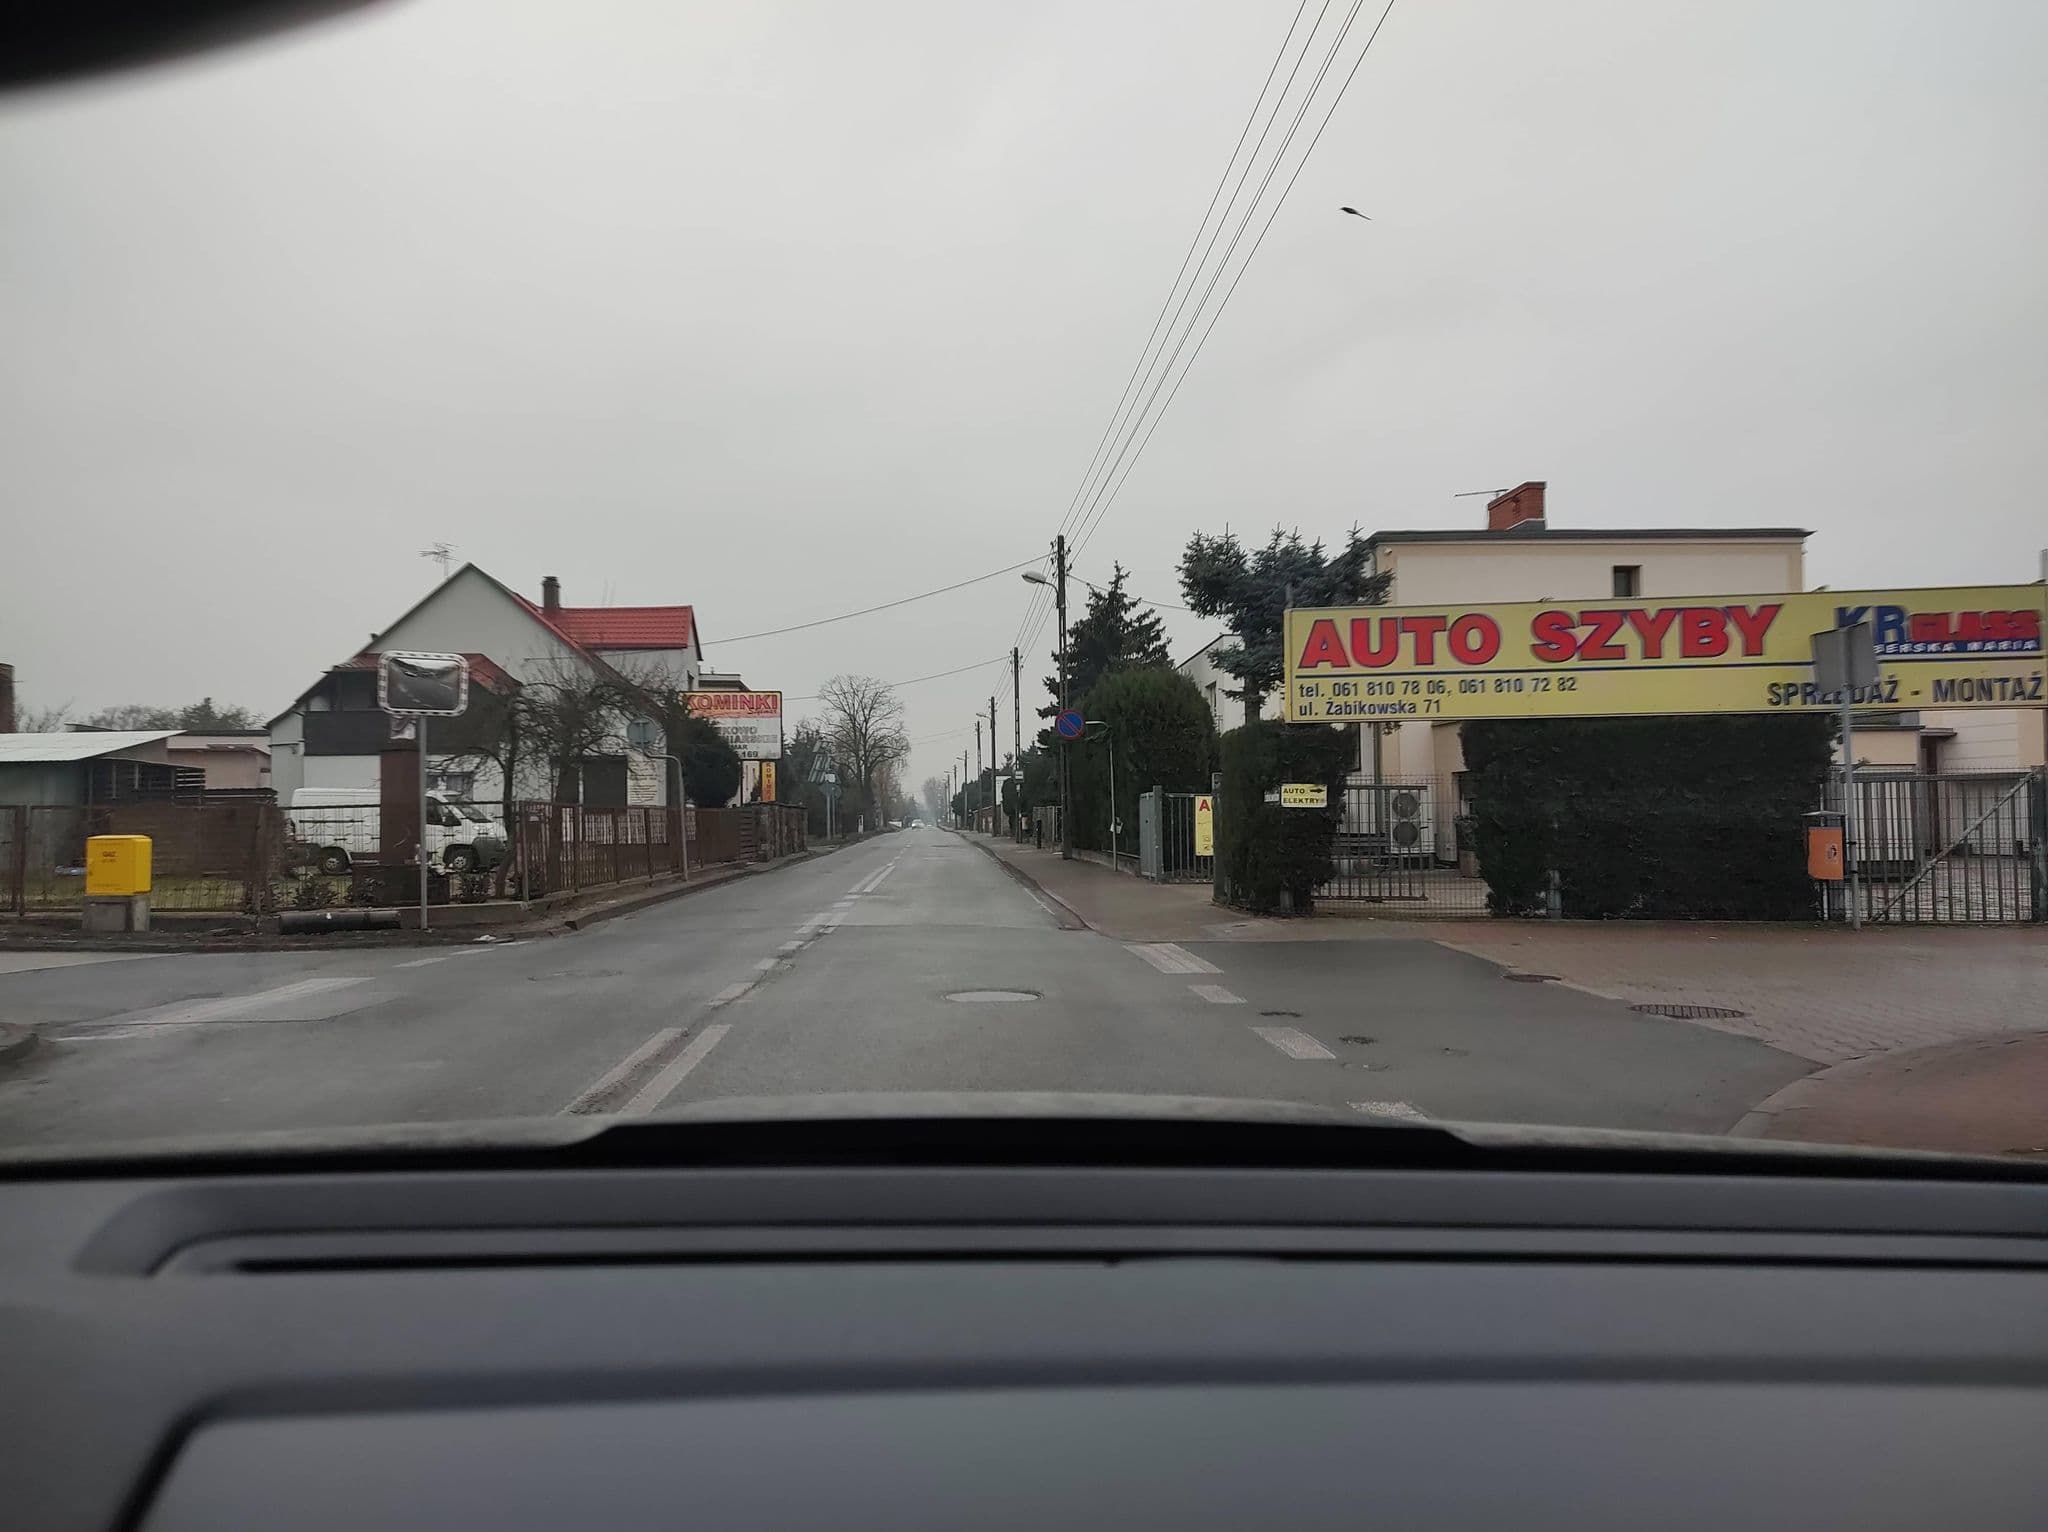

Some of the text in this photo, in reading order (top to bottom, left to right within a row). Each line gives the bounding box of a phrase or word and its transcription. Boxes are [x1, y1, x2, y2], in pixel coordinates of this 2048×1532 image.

[1298, 603, 1783, 669] AUTO SZYBY
[1299, 683, 1325, 698] tel.
[1333, 682, 1358, 697] 061
[1367, 681, 1394, 696] 810
[1401, 680, 1420, 695] 78
[1459, 679, 1486, 694] 061
[1494, 678, 1523, 693] 810
[1532, 677, 1550, 692] 72
[1557, 676, 1577, 692] 82
[1932, 671, 2042, 702] MONTAŻ
[687, 694, 778, 710] KOMINKI
[1299, 697, 1440, 716] ul. Żabikowska 71
